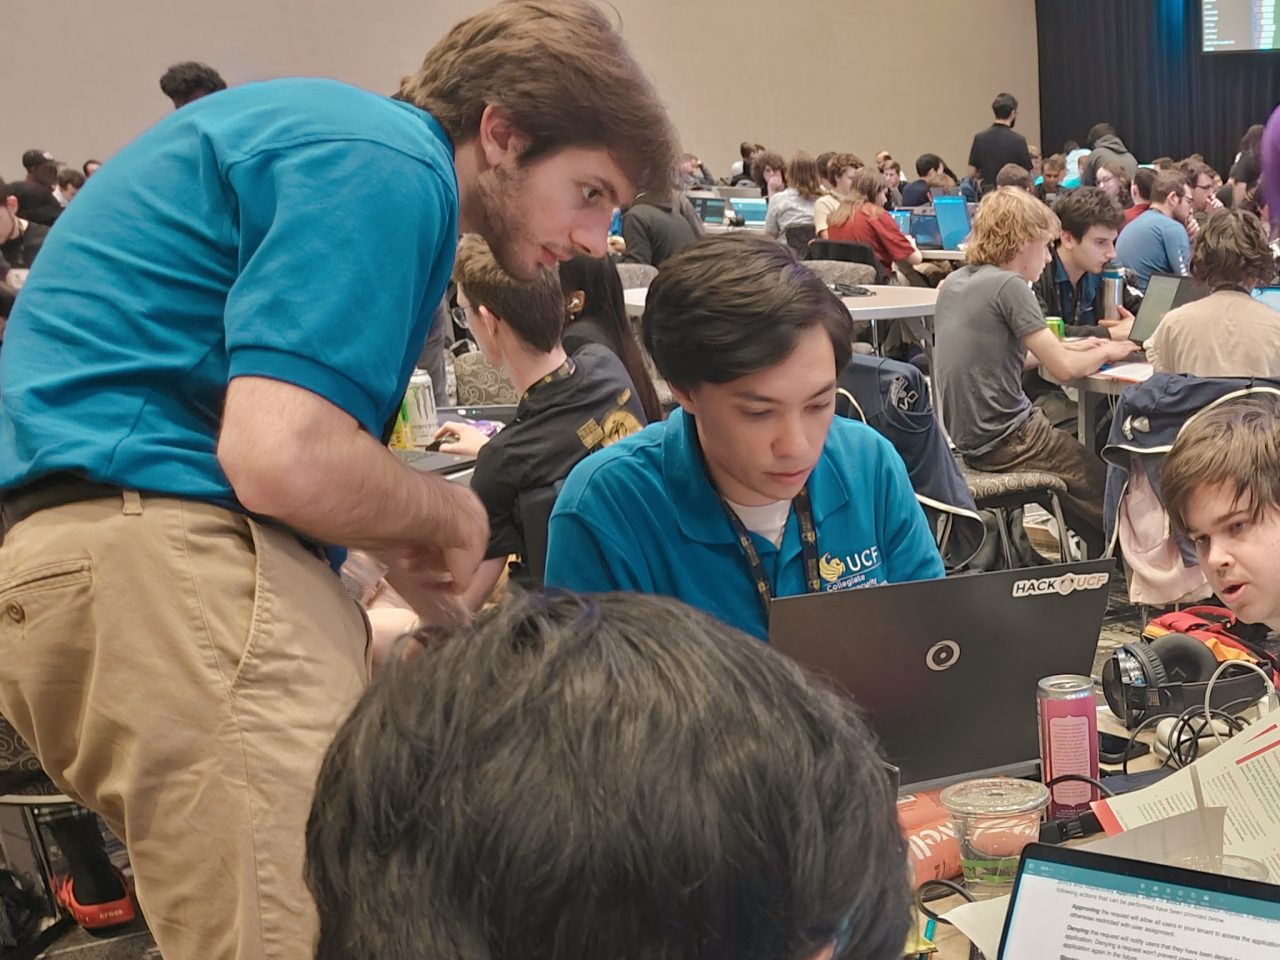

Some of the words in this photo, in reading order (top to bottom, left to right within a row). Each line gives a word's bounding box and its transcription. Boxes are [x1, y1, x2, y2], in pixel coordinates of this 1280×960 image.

[846, 546, 879, 571] UCF
[827, 574, 866, 592] Collegiate
[1016, 580, 1056, 594] HACK
[1077, 575, 1106, 587] UCF
[1066, 925, 1089, 934] Denying
[1099, 931, 1119, 940] request
[1130, 937, 1144, 945] notify
